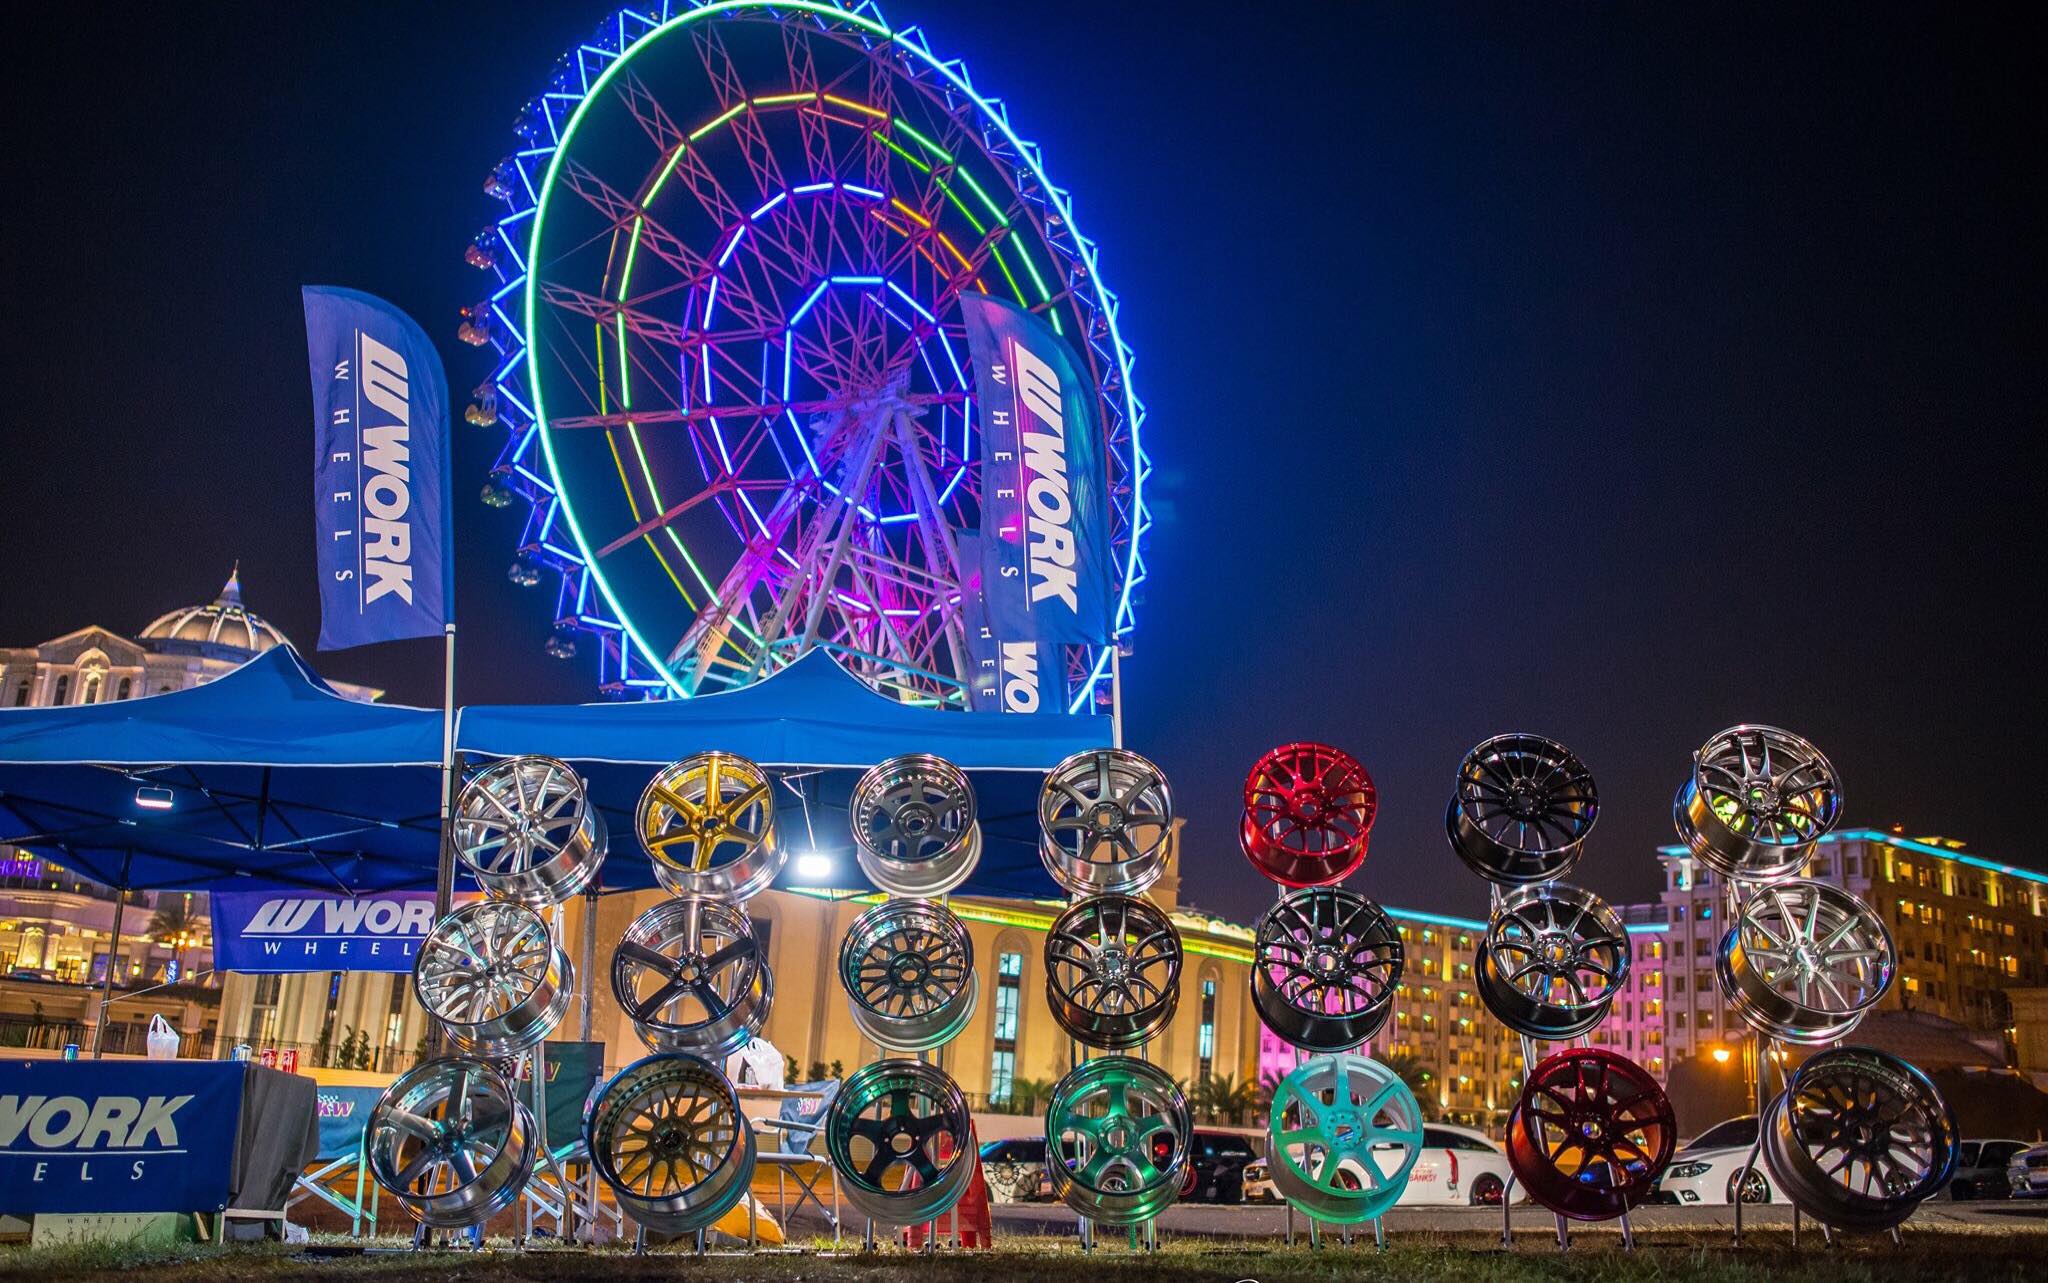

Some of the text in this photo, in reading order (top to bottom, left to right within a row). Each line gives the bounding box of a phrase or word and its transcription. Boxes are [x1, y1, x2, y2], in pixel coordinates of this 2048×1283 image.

[333, 359, 353, 581] WHEELS
[363, 425, 413, 605] WORK
[991, 364, 1019, 578] WHEELS
[1023, 431, 1078, 614] WORK
[1003, 642, 1040, 713] WO
[264, 942, 412, 956] WHEEL
[324, 899, 436, 935] WOR
[33, 1160, 145, 1181] ELS
